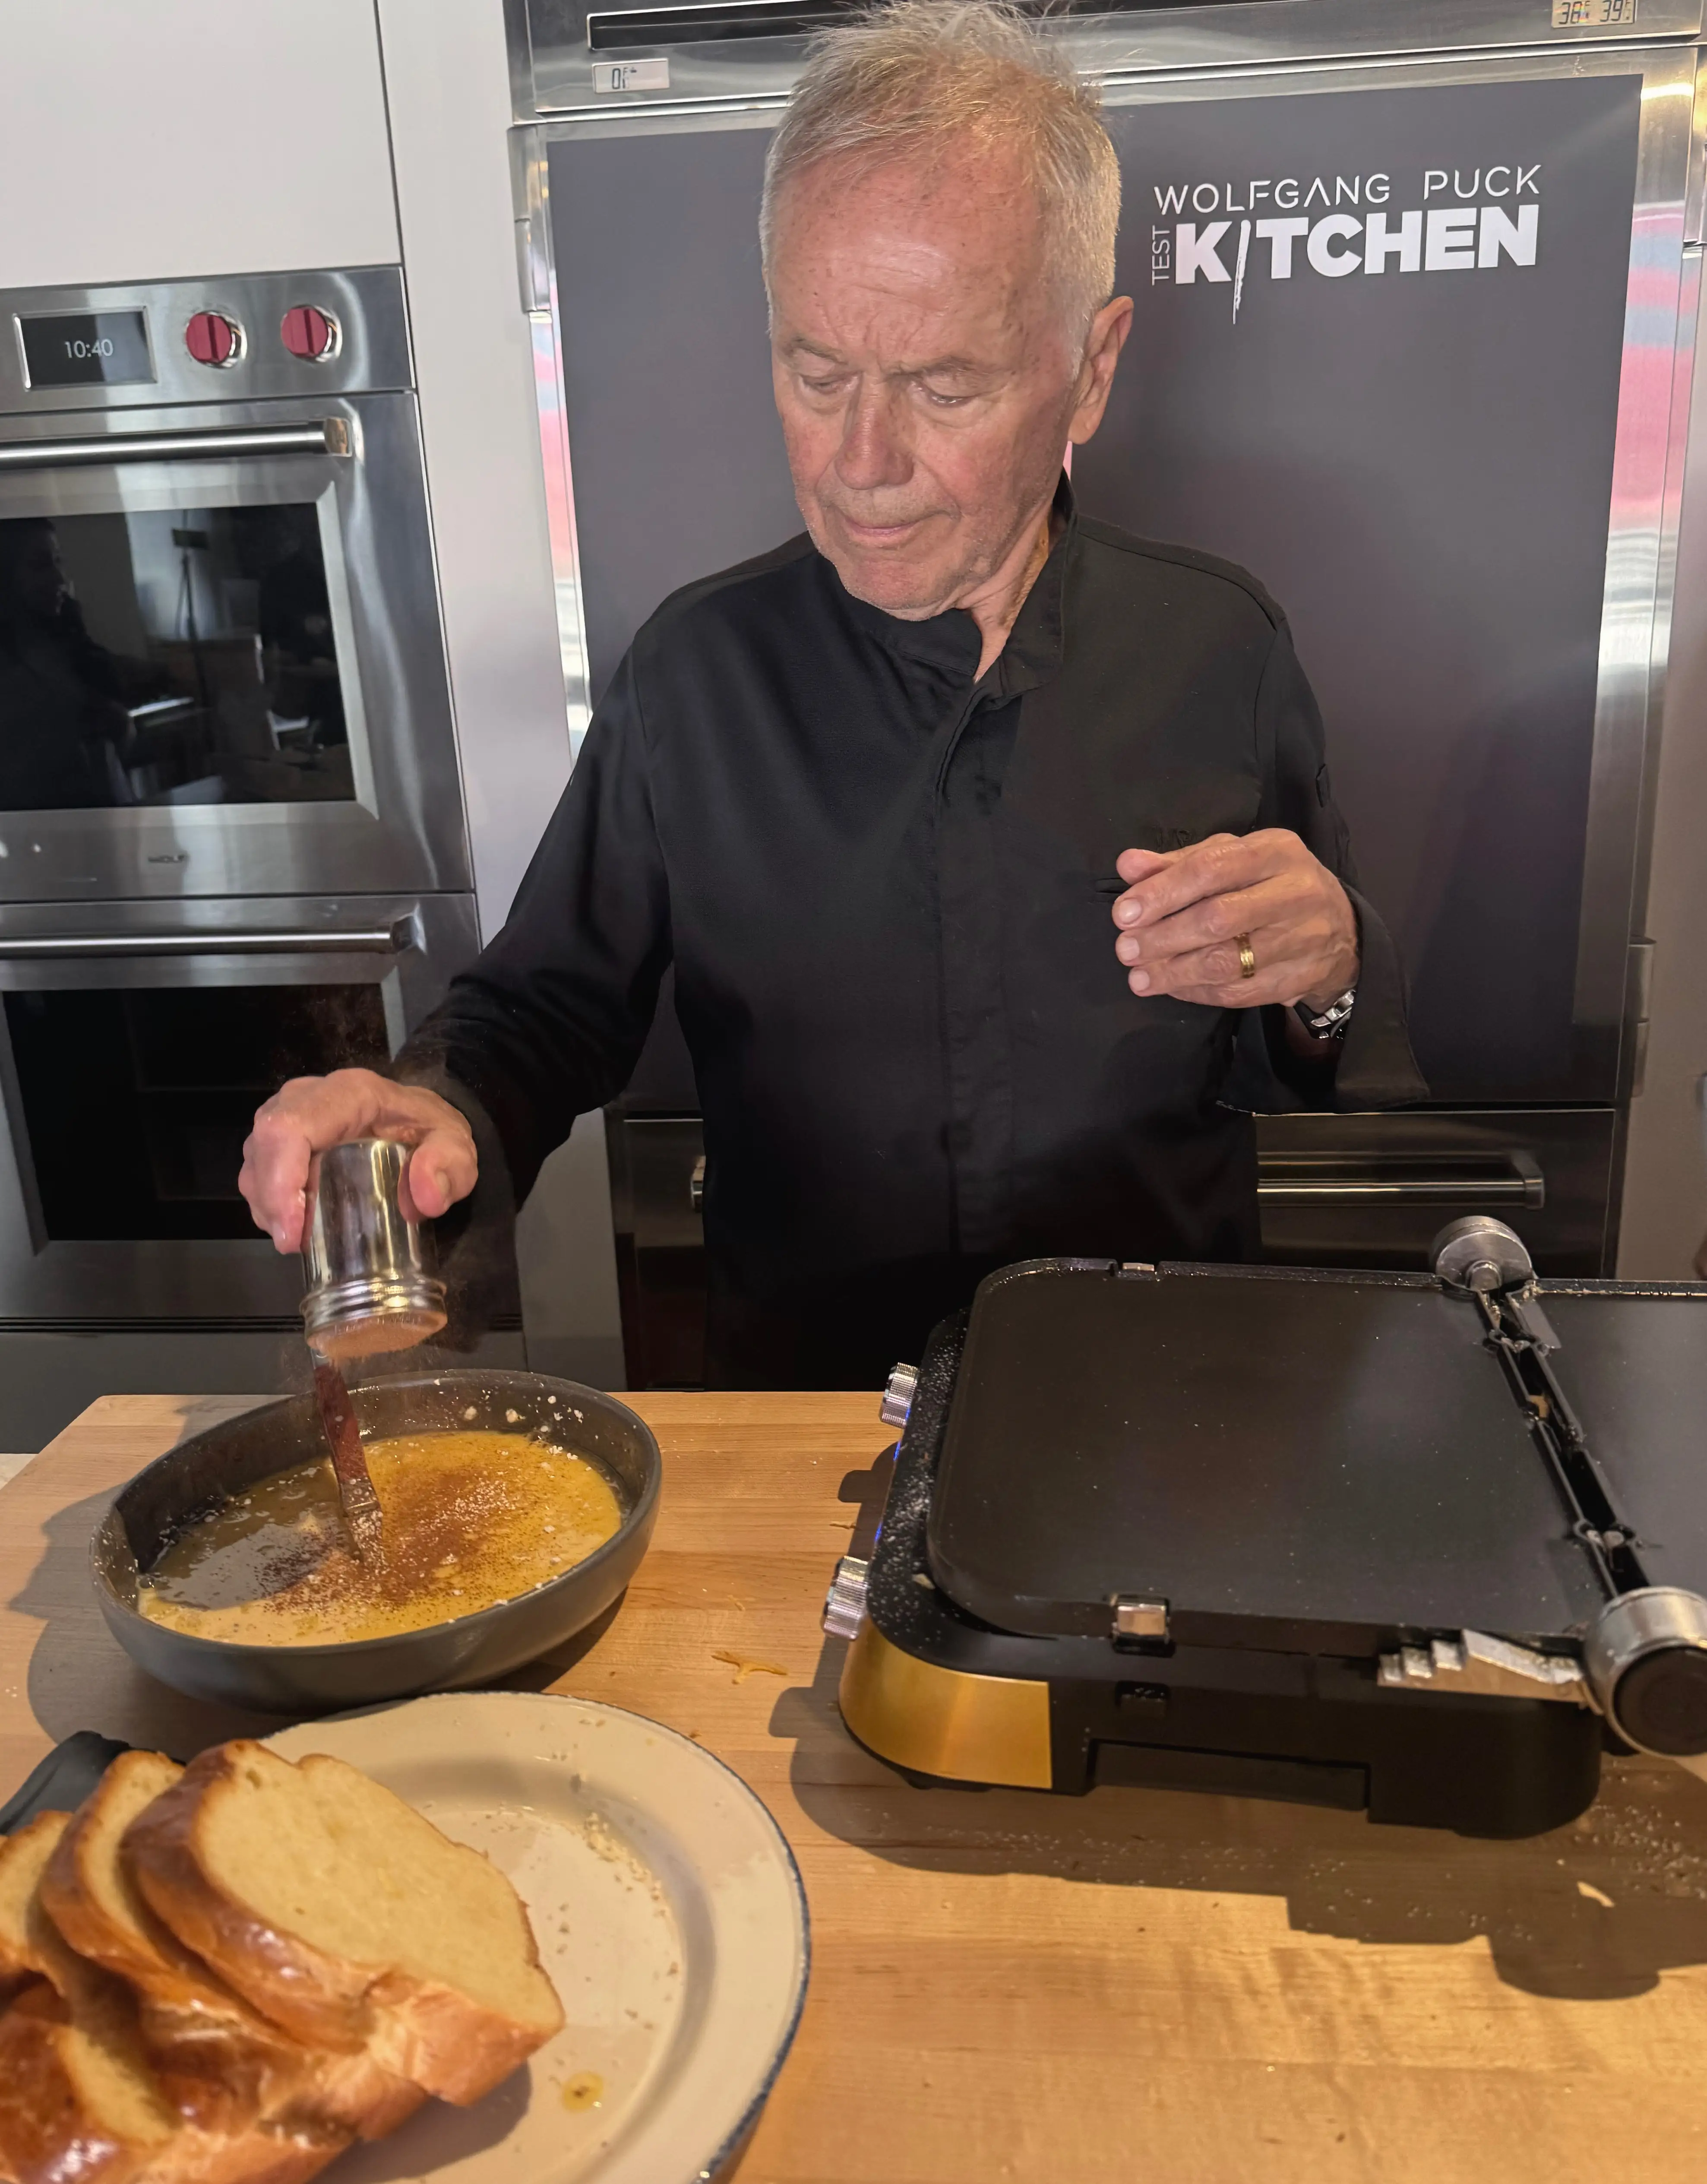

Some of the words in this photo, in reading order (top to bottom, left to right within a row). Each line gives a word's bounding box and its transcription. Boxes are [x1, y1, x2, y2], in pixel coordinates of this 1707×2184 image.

[1153, 173, 1390, 215] WOLFGANG
[1423, 164, 1542, 200] PUCK
[1151, 225, 1170, 286] TEST
[1175, 204, 1540, 324] KITCHEN
[64, 339, 113, 358] 10:40
